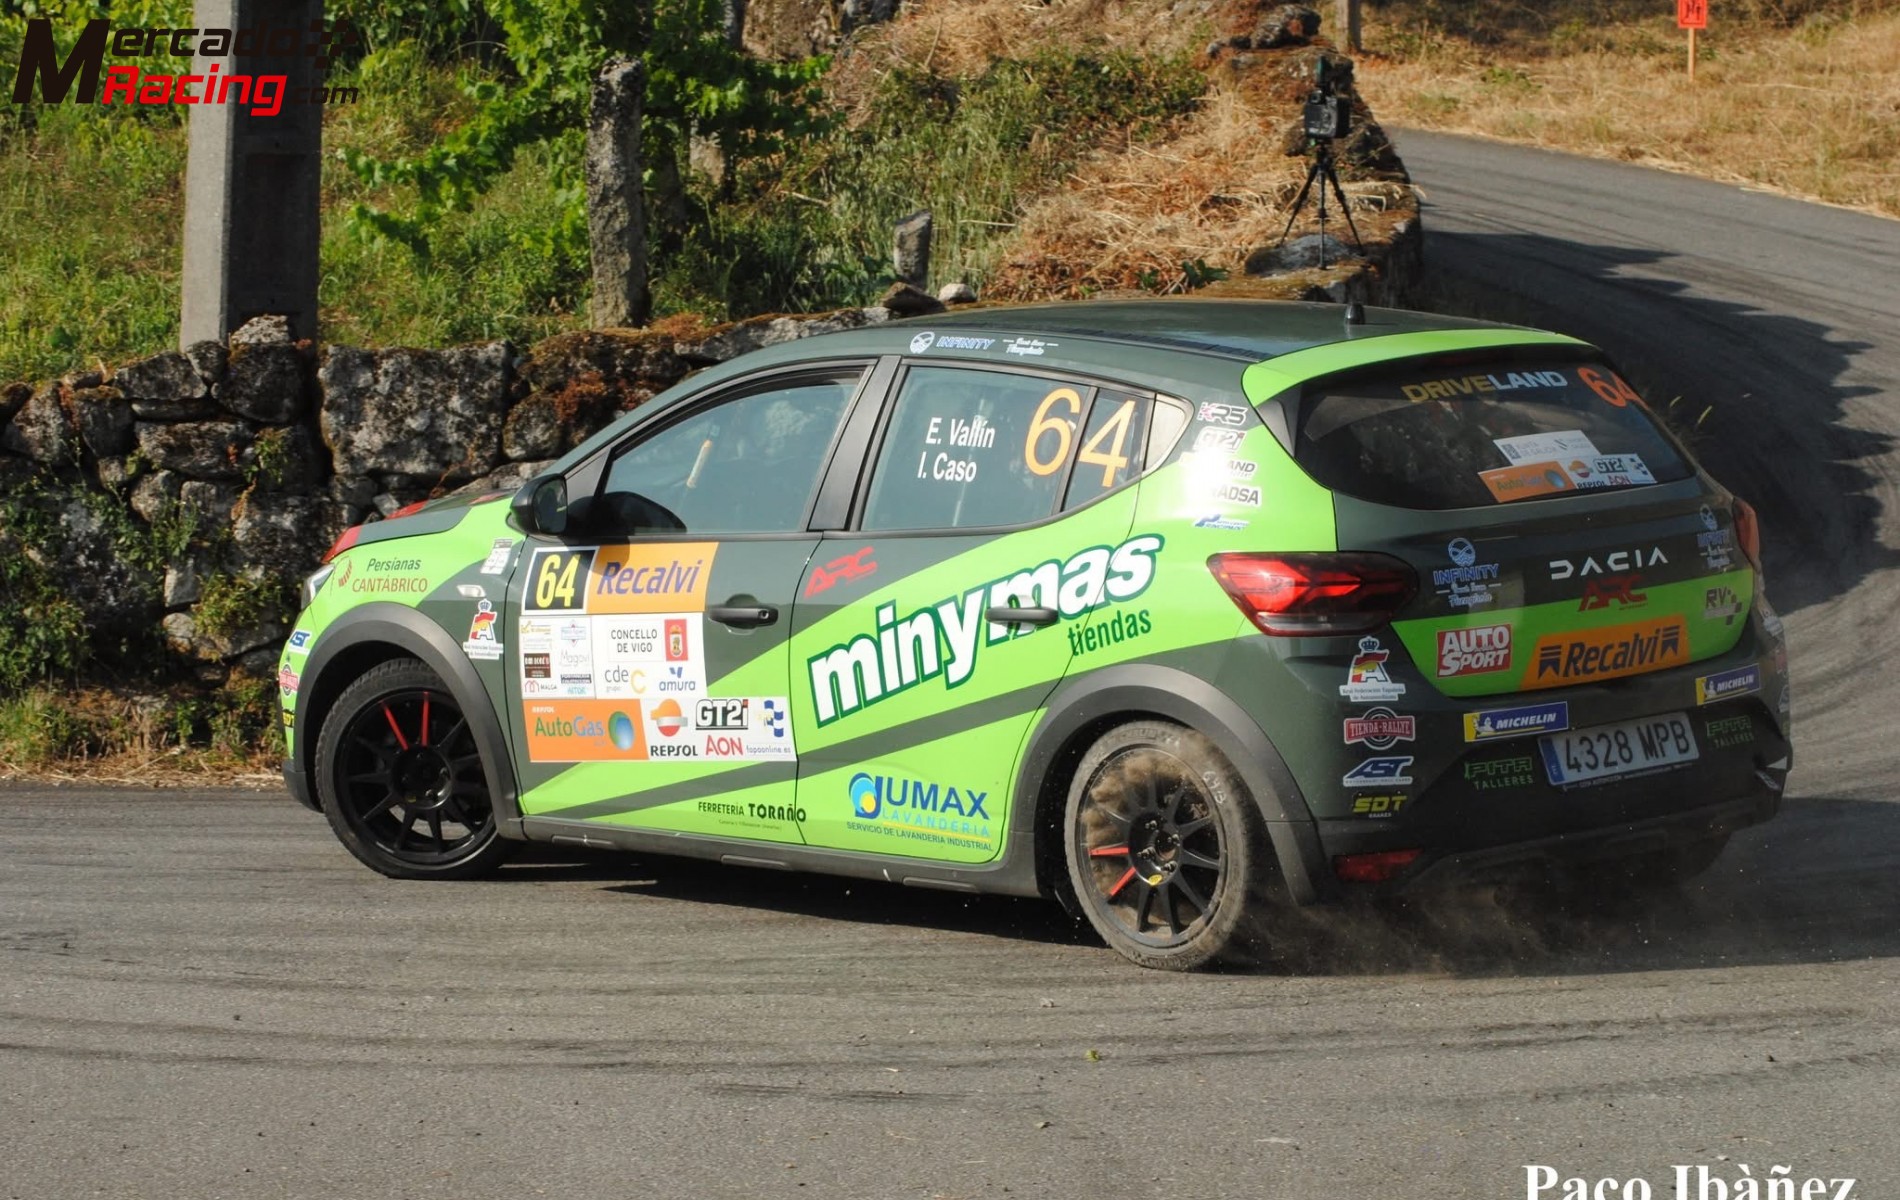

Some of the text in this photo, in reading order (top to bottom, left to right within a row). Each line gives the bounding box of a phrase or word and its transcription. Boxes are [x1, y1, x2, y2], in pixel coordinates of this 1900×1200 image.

[935, 336, 996, 350] INFINITY
[925, 417, 942, 444] E.
[1024, 388, 1136, 487] 64
[917, 452, 978, 482] I. Caso
[366, 557, 423, 573] Persianas
[1433, 563, 1500, 586] INFINITY
[1549, 547, 1668, 580] DACIA
[352, 574, 428, 593] CANTÁBRICO
[535, 553, 581, 609] 64
[597, 559, 704, 595] Recalvi
[610, 629, 658, 640] CONCELLO
[807, 534, 1166, 729] minymas
[1067, 607, 1152, 657] tiendas
[1442, 625, 1509, 655] AUTO
[617, 642, 653, 653] DE VIGO
[1563, 629, 1660, 678] Recalvi
[1438, 650, 1509, 677] SPORT
[658, 680, 696, 692] amura
[1717, 674, 1755, 692] MICHELIN
[695, 698, 749, 729] GT2i
[1496, 713, 1557, 730] MICHELIN
[535, 715, 605, 737] AutoGas
[650, 743, 699, 757] REPSOL
[705, 734, 744, 756] AON
[1566, 720, 1690, 774] 4328 MPB
[1474, 774, 1534, 790] TALLERES
[748, 803, 807, 823] TORAÑO
[1353, 795, 1408, 813] SDT
[846, 821, 883, 835] SERVICIO
[883, 828, 895, 837] DE
[947, 837, 994, 851] INDUSTRIAL
